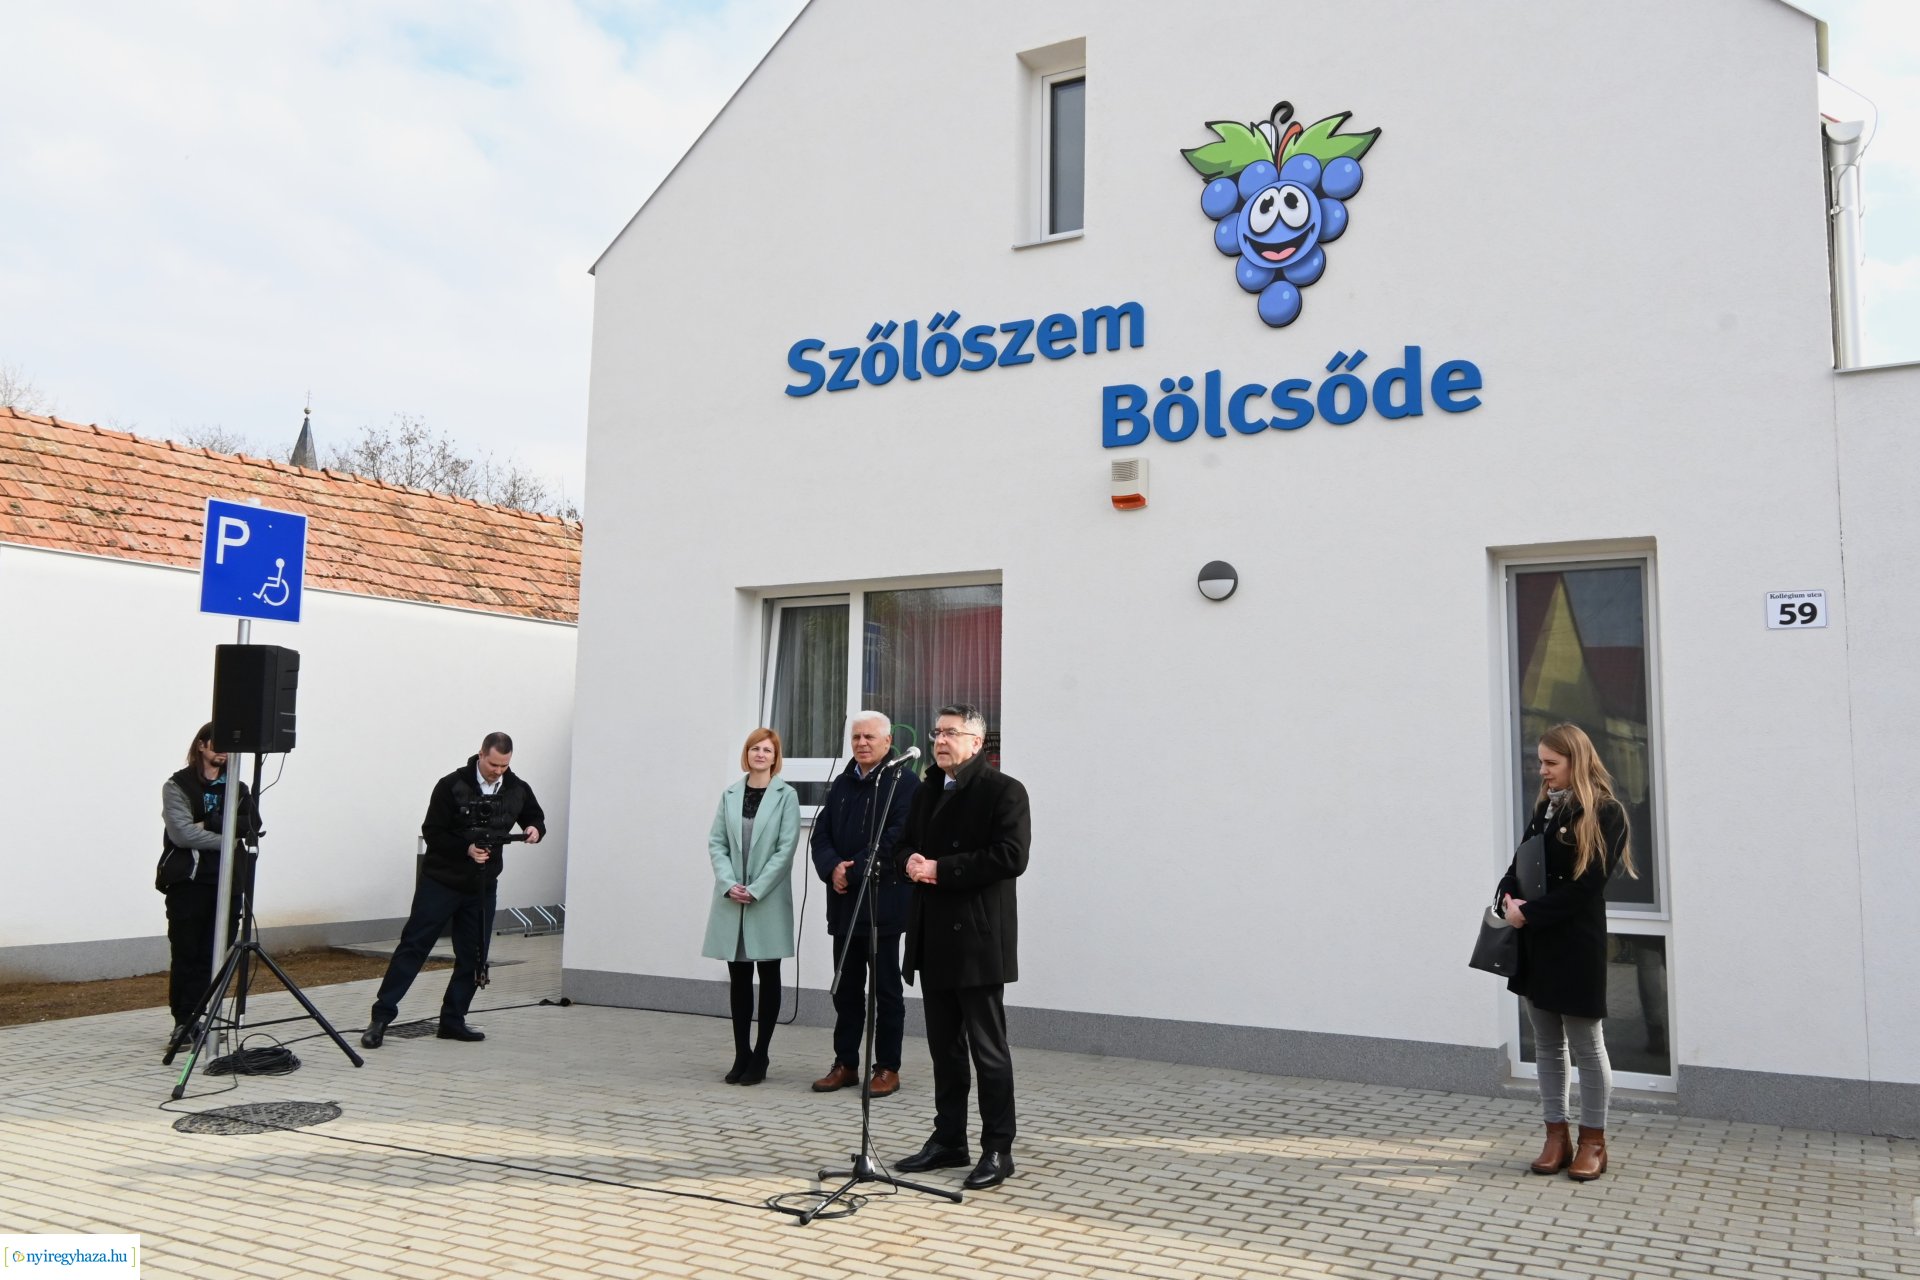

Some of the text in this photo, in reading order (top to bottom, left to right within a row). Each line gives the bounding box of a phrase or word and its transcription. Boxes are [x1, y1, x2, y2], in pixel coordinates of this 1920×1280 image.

[785, 302, 1145, 397] Szőlőszem
[1102, 345, 1483, 448] Bölcsőde
[216, 516, 250, 565] P
[1779, 602, 1817, 625] 59
